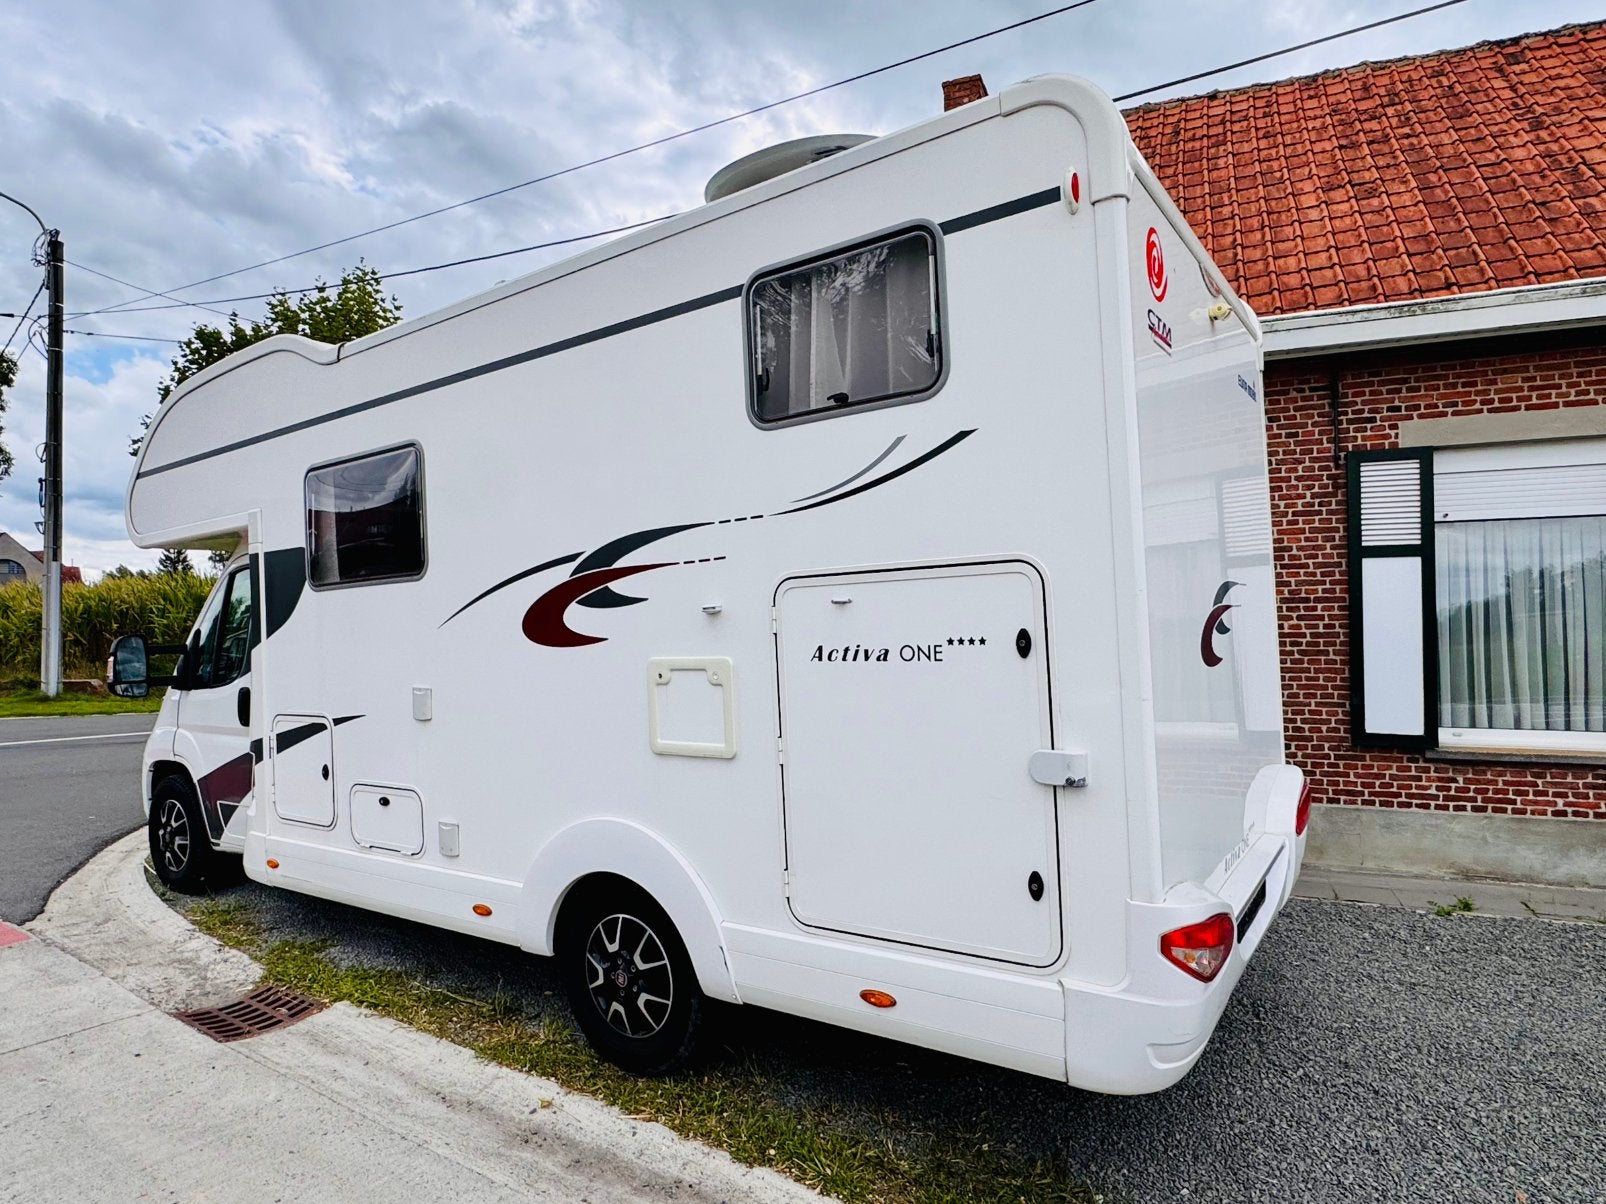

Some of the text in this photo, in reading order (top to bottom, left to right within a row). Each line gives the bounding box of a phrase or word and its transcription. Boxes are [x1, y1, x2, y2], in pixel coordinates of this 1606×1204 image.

[1147, 308, 1172, 343] CTM
[810, 644, 943, 662] Activa ONE
